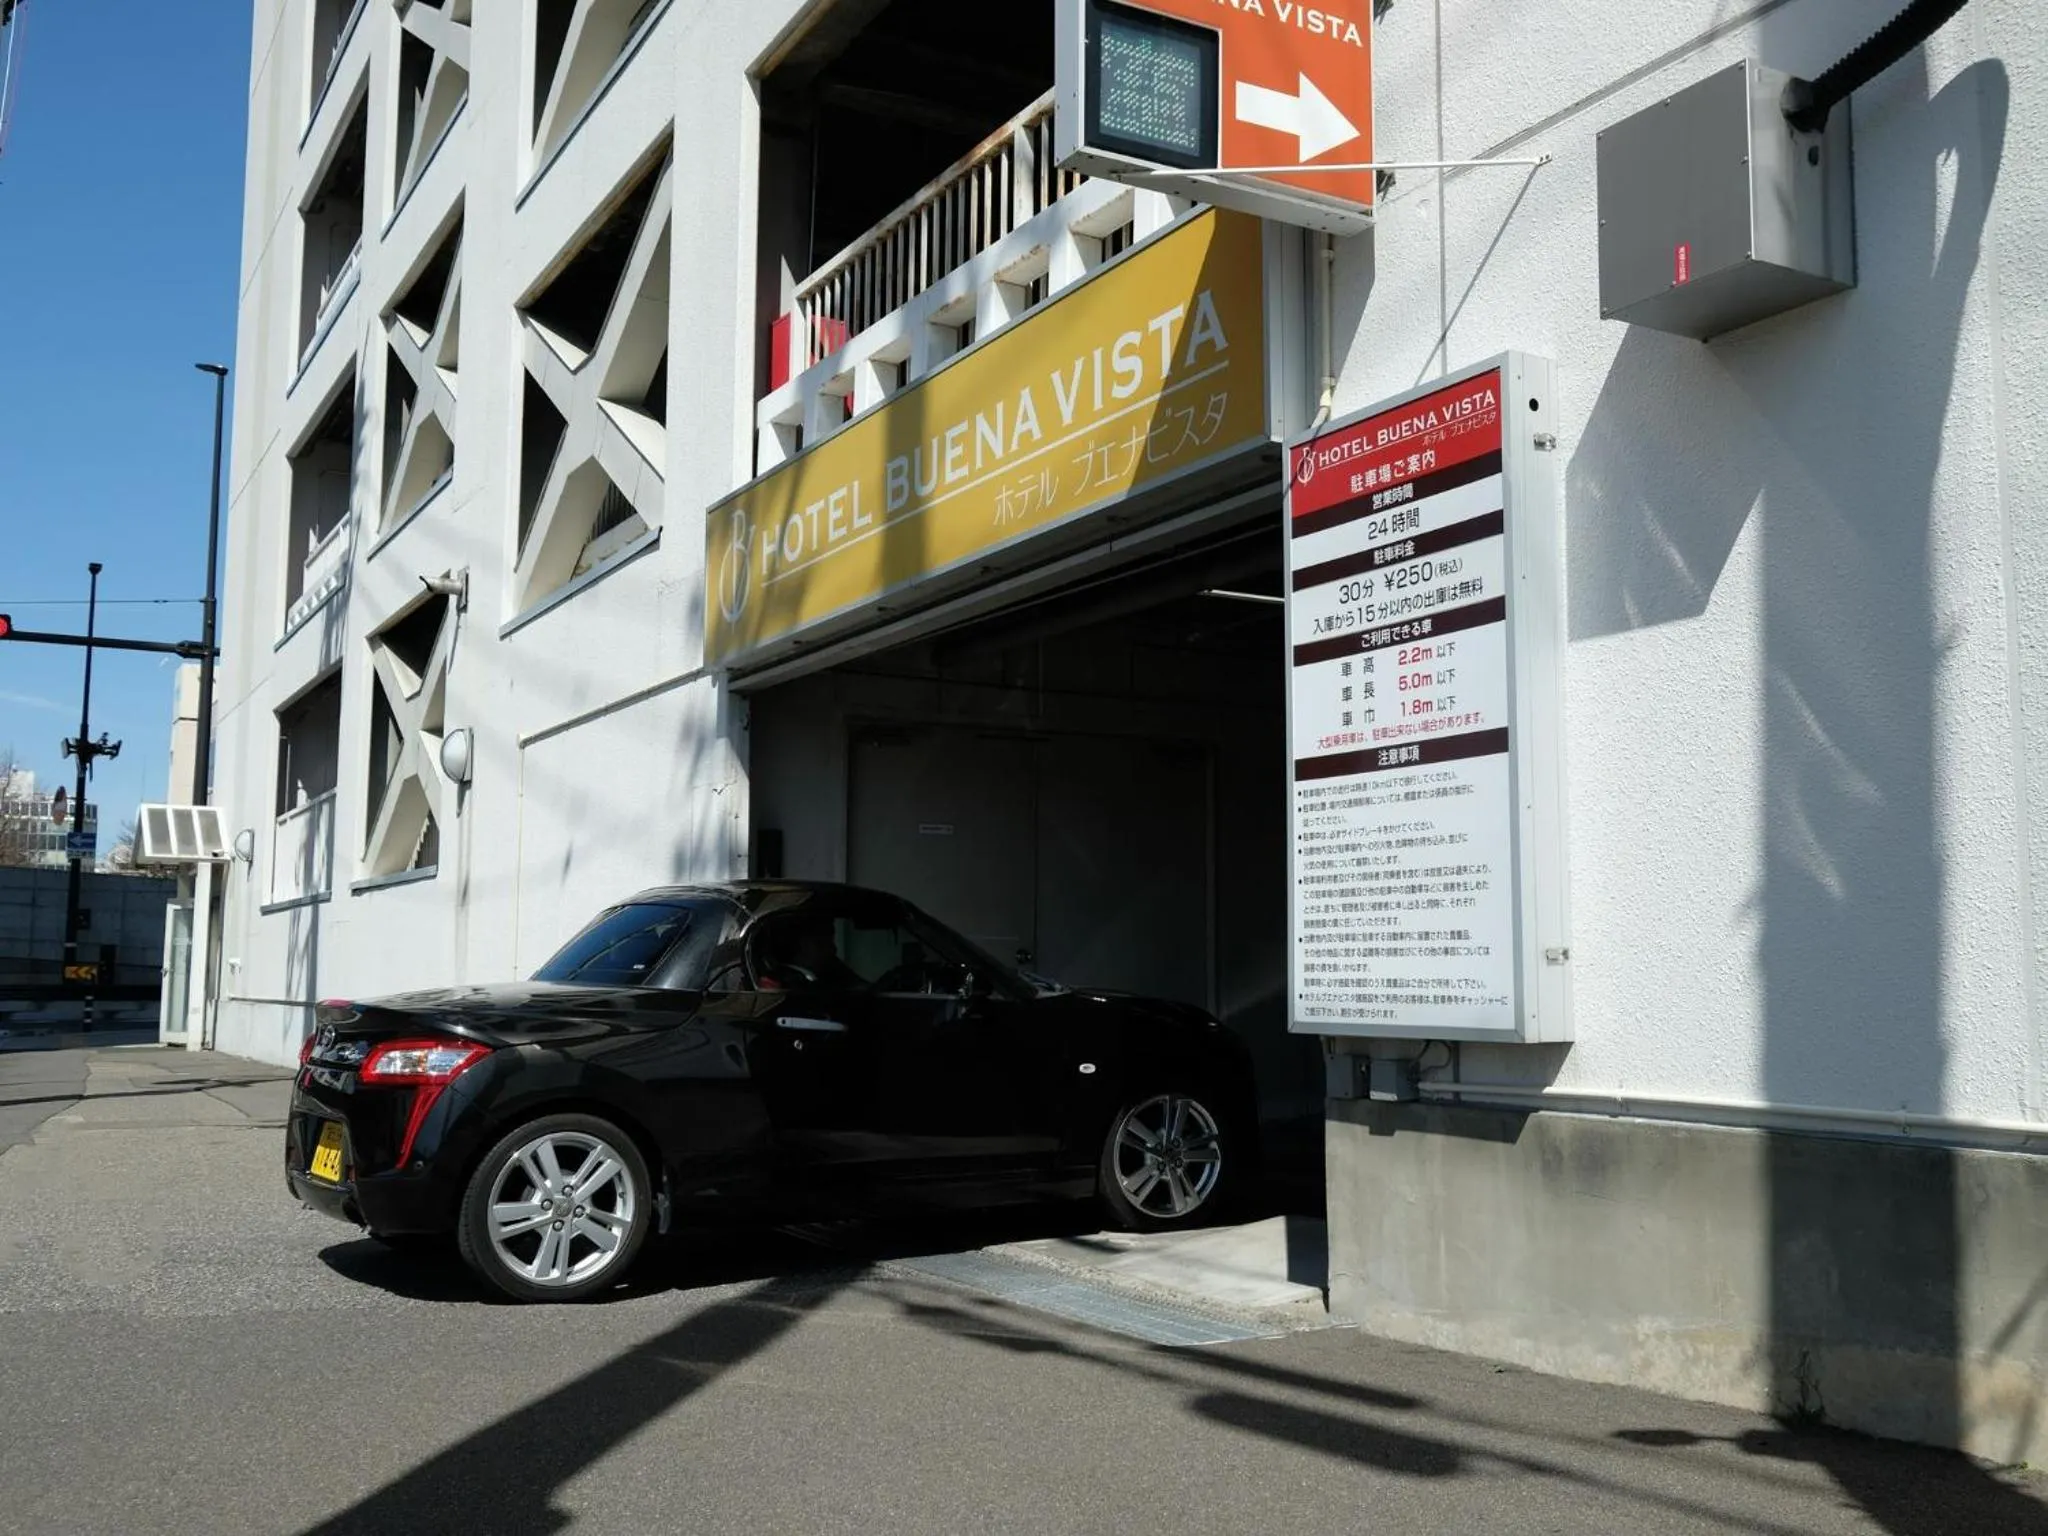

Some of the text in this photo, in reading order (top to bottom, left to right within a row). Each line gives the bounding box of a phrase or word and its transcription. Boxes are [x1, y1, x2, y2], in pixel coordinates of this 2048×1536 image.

[1273, 0, 1363, 48] VISTA
[761, 289, 1228, 576] HOTEL BUENA VISTA
[1319, 389, 1495, 466] HOTEL BUENA VISTA
[1422, 431, 1445, 447] ホテル
[992, 392, 1228, 527] ホテル ブエナビスタ
[1351, 449, 1436, 493] 駐車場ご案内
[1372, 485, 1414, 510] 営業時間
[1374, 541, 1415, 565] 駐車料金
[1339, 579, 1375, 605] 30分
[1362, 619, 1433, 648] ご利用できる車
[1378, 745, 1420, 766] 注意事項
